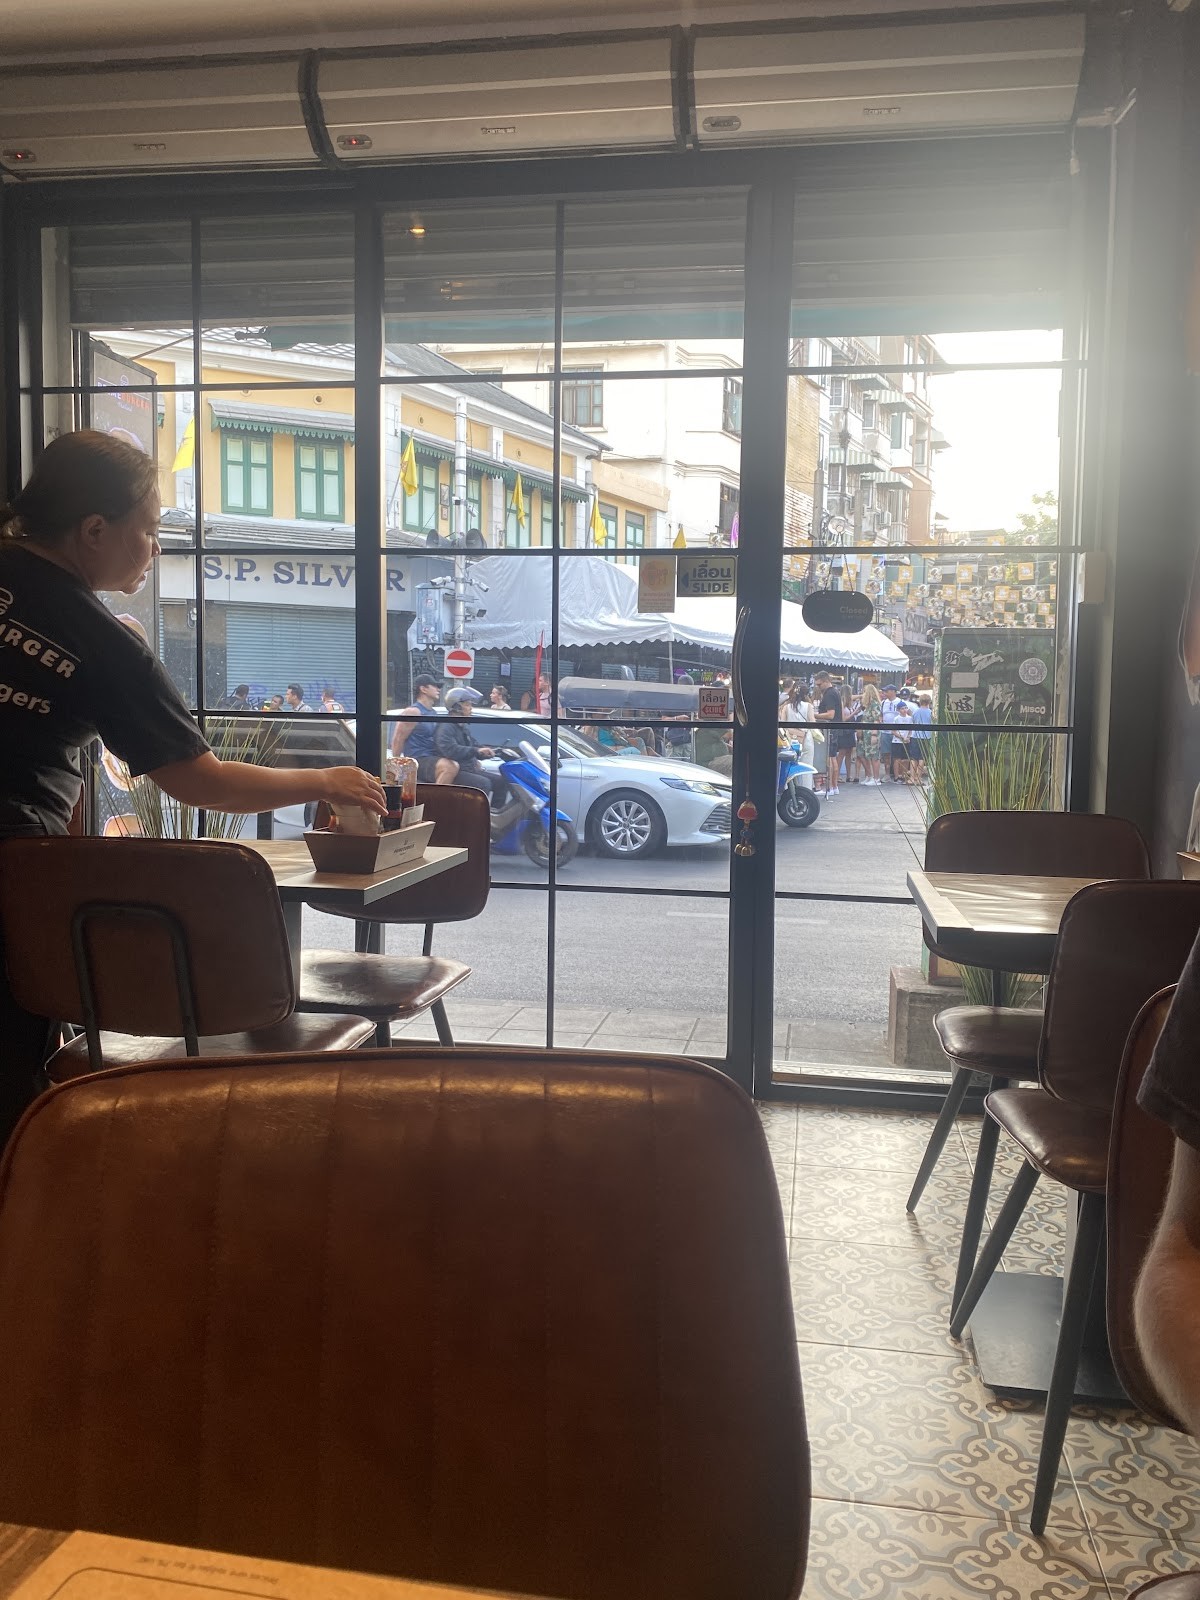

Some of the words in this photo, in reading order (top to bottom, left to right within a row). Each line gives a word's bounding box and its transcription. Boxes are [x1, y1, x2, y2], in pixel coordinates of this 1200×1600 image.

[204, 556, 260, 582] S.P.
[273, 561, 406, 592] SILVR
[692, 559, 732, 579] เลื่อน
[692, 582, 730, 593] SLIDE
[839, 605, 868, 615] Closed
[705, 706, 724, 714] SLIDE
